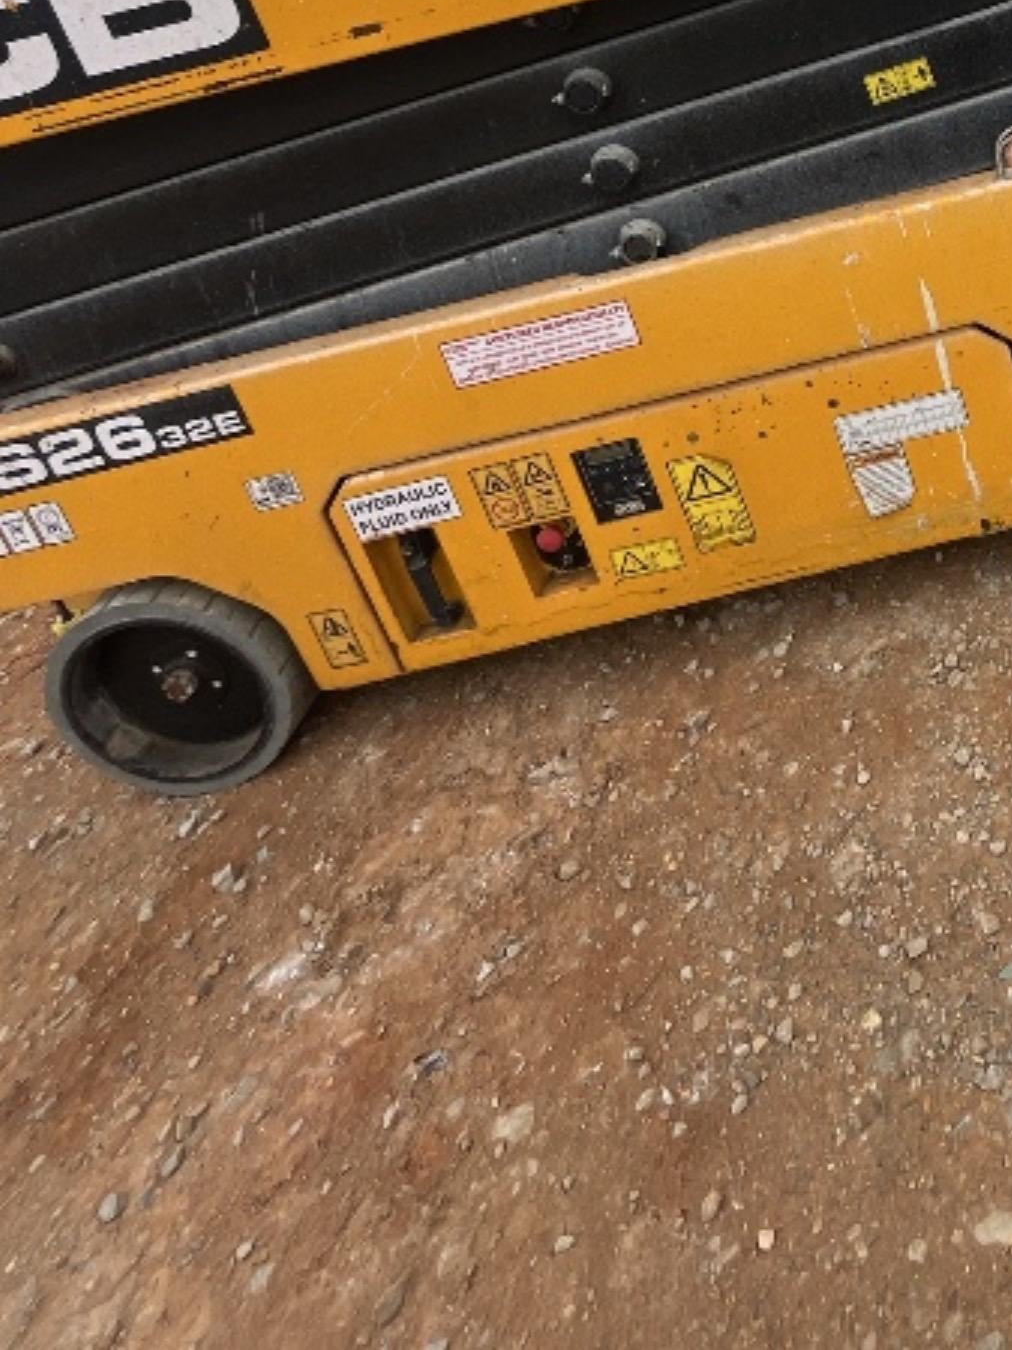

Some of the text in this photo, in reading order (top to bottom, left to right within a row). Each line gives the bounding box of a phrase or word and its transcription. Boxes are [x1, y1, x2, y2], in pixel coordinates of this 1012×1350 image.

[350, 481, 448, 518] HYDRAULIC
[357, 500, 452, 535] FLUID ONLY
